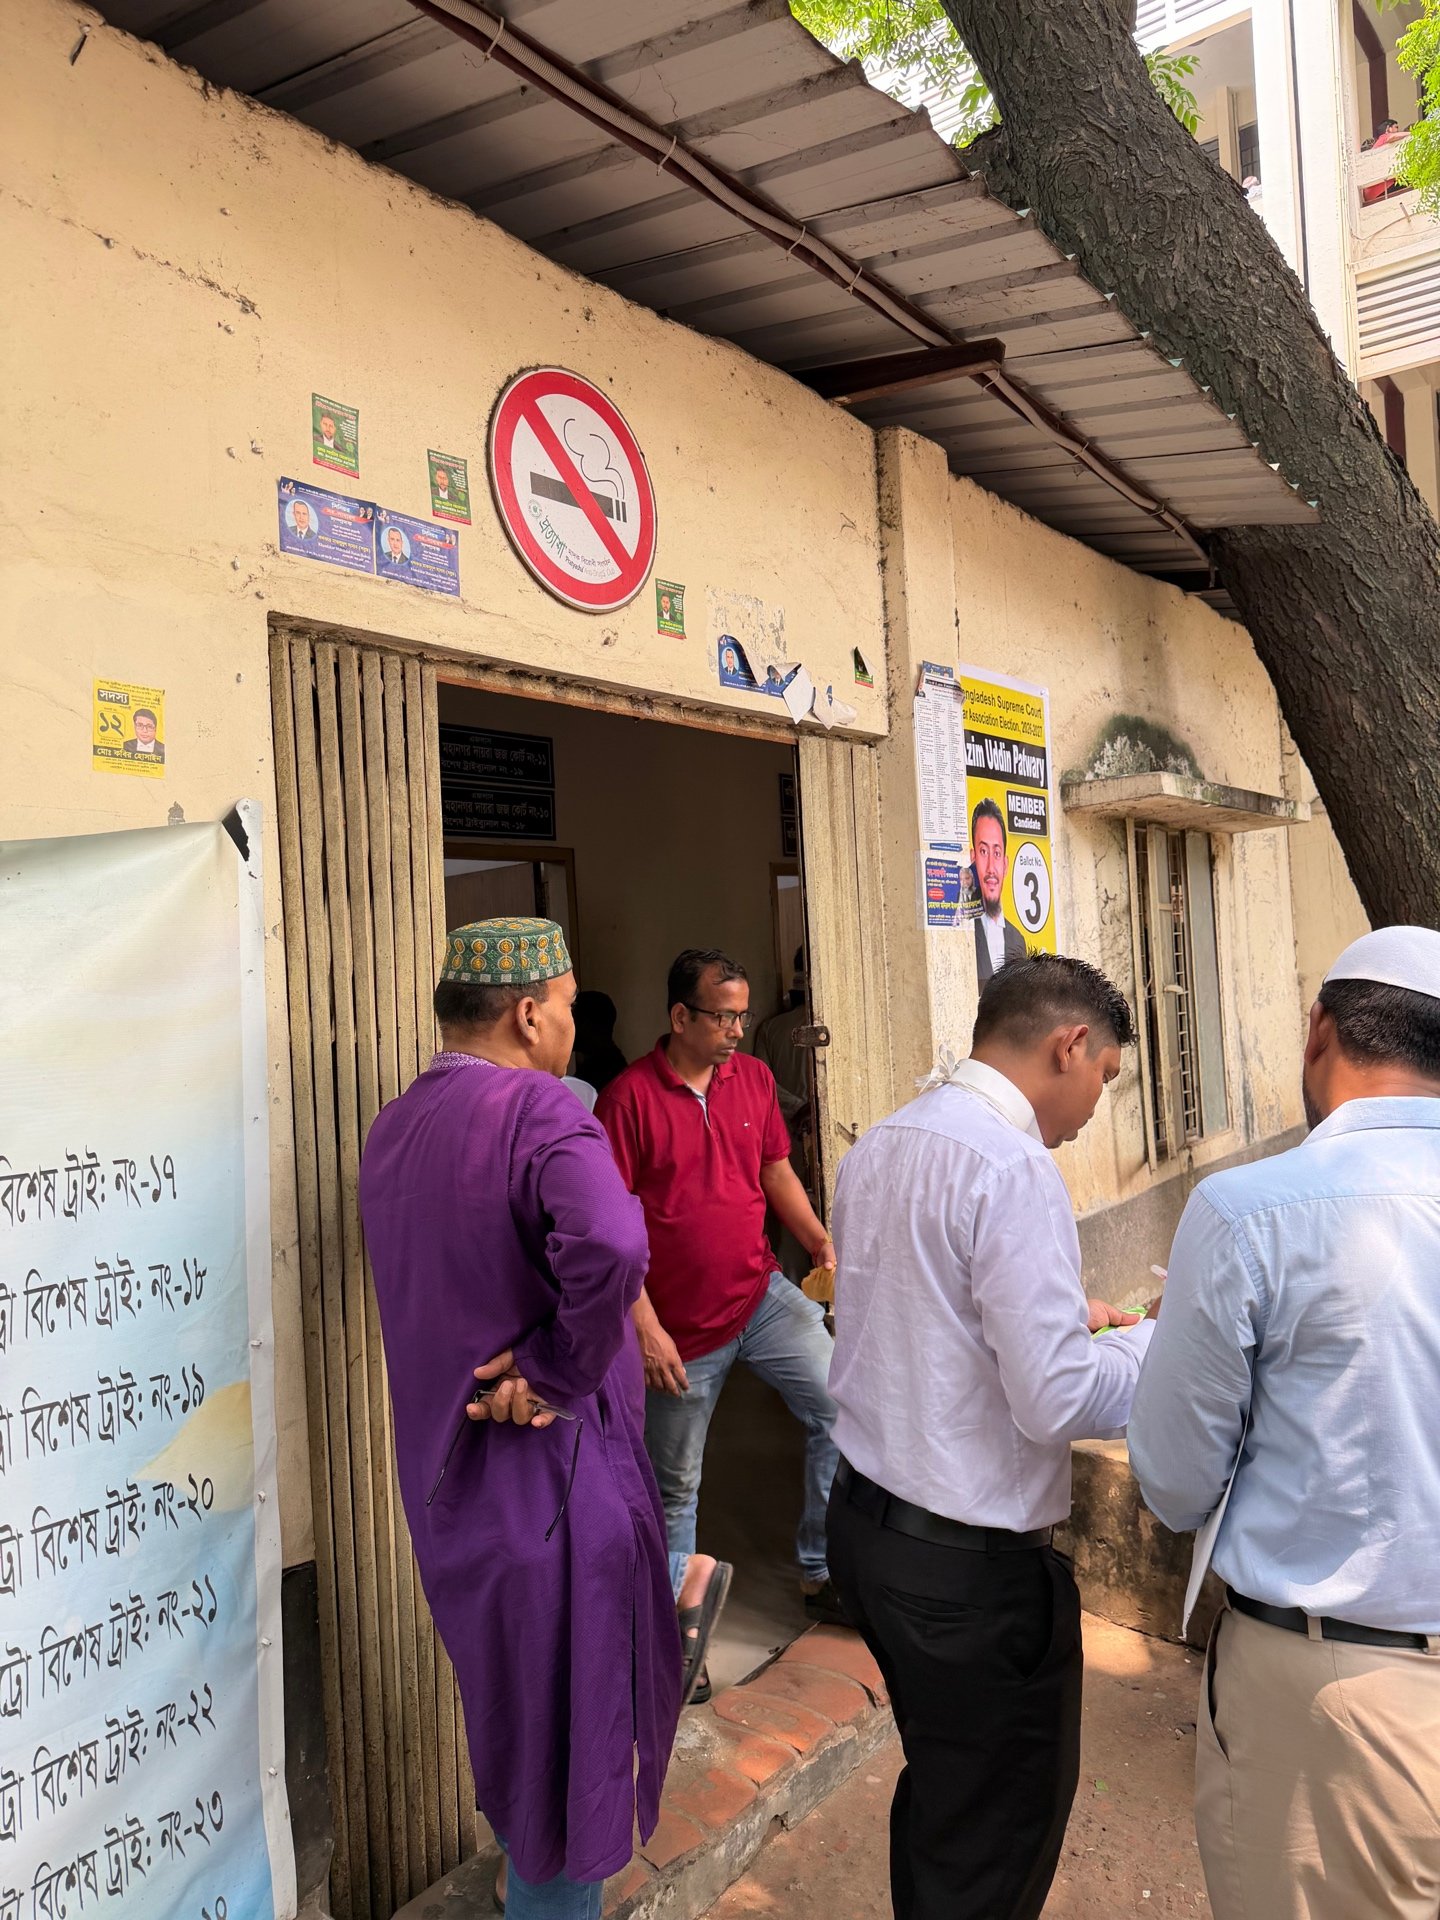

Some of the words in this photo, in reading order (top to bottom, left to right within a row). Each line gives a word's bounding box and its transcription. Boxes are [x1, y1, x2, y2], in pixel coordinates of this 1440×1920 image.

[100, 712, 124, 737] ১২
[969, 708, 999, 727] Association
[997, 695, 1025, 714] Supreme
[1026, 703, 1042, 719] Court
[985, 738, 1012, 774] Uddin
[1012, 744, 1045, 787] Patwary
[1008, 794, 1045, 816] MEMBER
[1014, 816, 1041, 830] Candidate
[1020, 855, 1034, 866] Ballot
[1035, 857, 1043, 867] No.
[1024, 872, 1041, 925] 3
[112, 1154, 177, 1208] নং-১৭
[23, 1268, 88, 1340] বিশেষ
[148, 1257, 208, 1312] নং-১৮
[20, 1386, 91, 1460] বিশেষ
[149, 1362, 205, 1422] নং-১৯
[30, 1505, 99, 1580] বিশেষ
[152, 1473, 214, 1531] নং-২০
[38, 1623, 104, 1699] বিশেষ
[157, 1574, 218, 1640] নং-২১
[31, 1740, 99, 1821] বিশেষ
[156, 1682, 217, 1750] নং-২২
[30, 1850, 98, 1920] বিশেষ
[157, 1790, 224, 1861] নং-২৩
